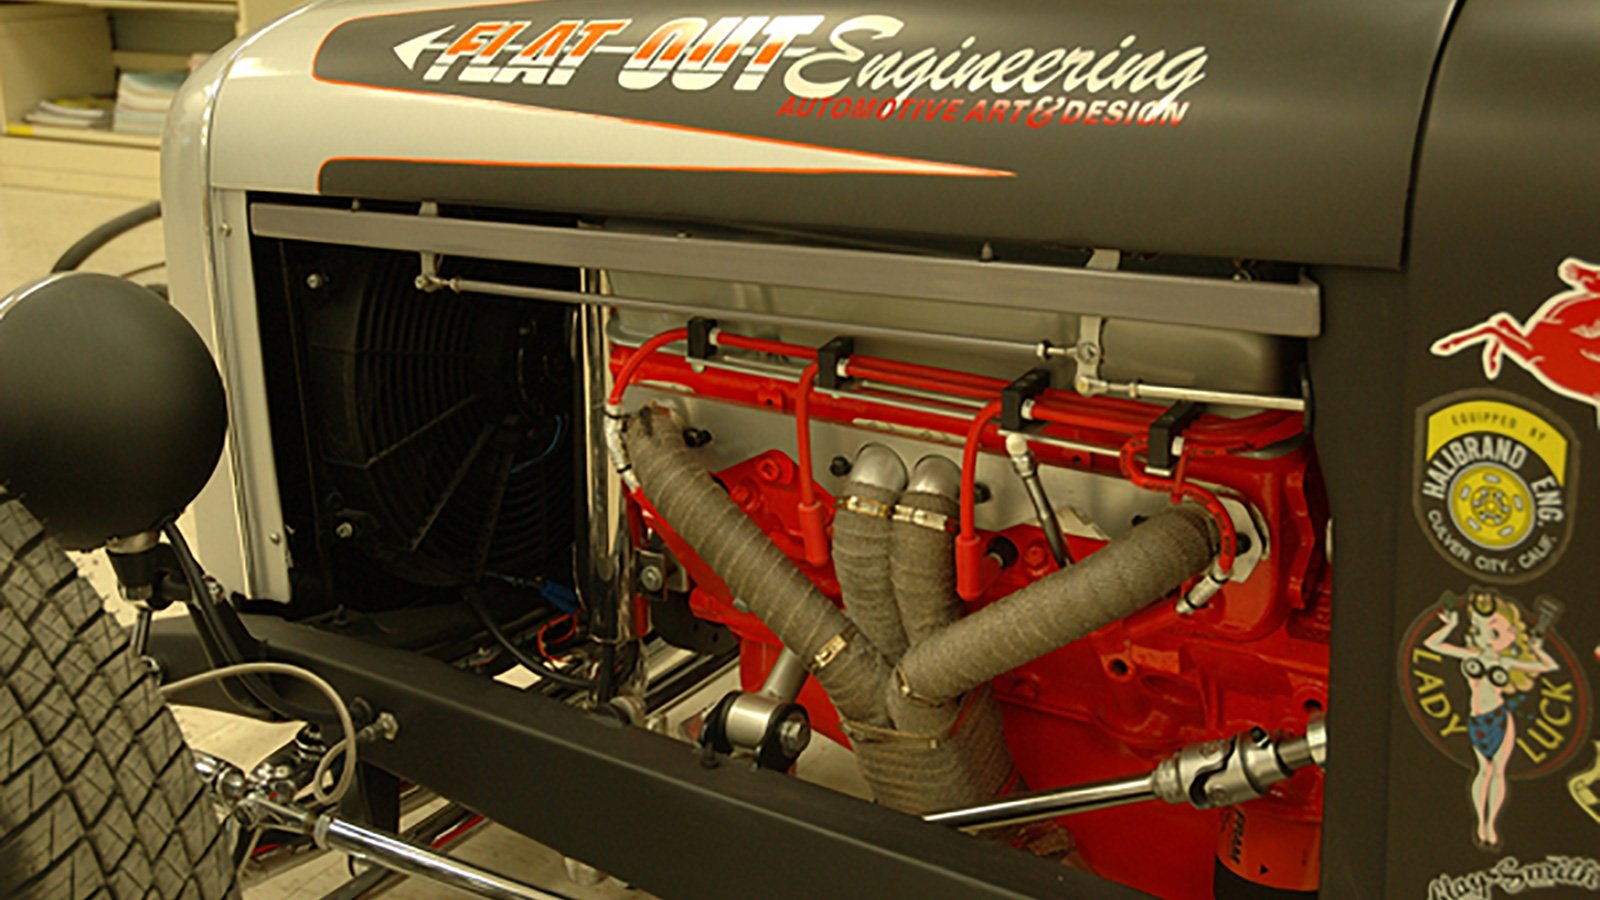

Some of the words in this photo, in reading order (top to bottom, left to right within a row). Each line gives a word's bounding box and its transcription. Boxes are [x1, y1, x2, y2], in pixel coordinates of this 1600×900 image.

[423, 19, 632, 85] FLAT
[618, 15, 825, 91] OUT
[783, 14, 1208, 118] Engineering
[775, 95, 960, 123] AUTOMOTIVE
[1451, 412, 1517, 430] EQUIPPED
[1422, 435, 1527, 499] HALIBRAND
[1428, 510, 1472, 562] CULVER
[1412, 648, 1467, 738] LADY
[1516, 677, 1573, 764] LUCK
[1231, 807, 1245, 864] FRAM
